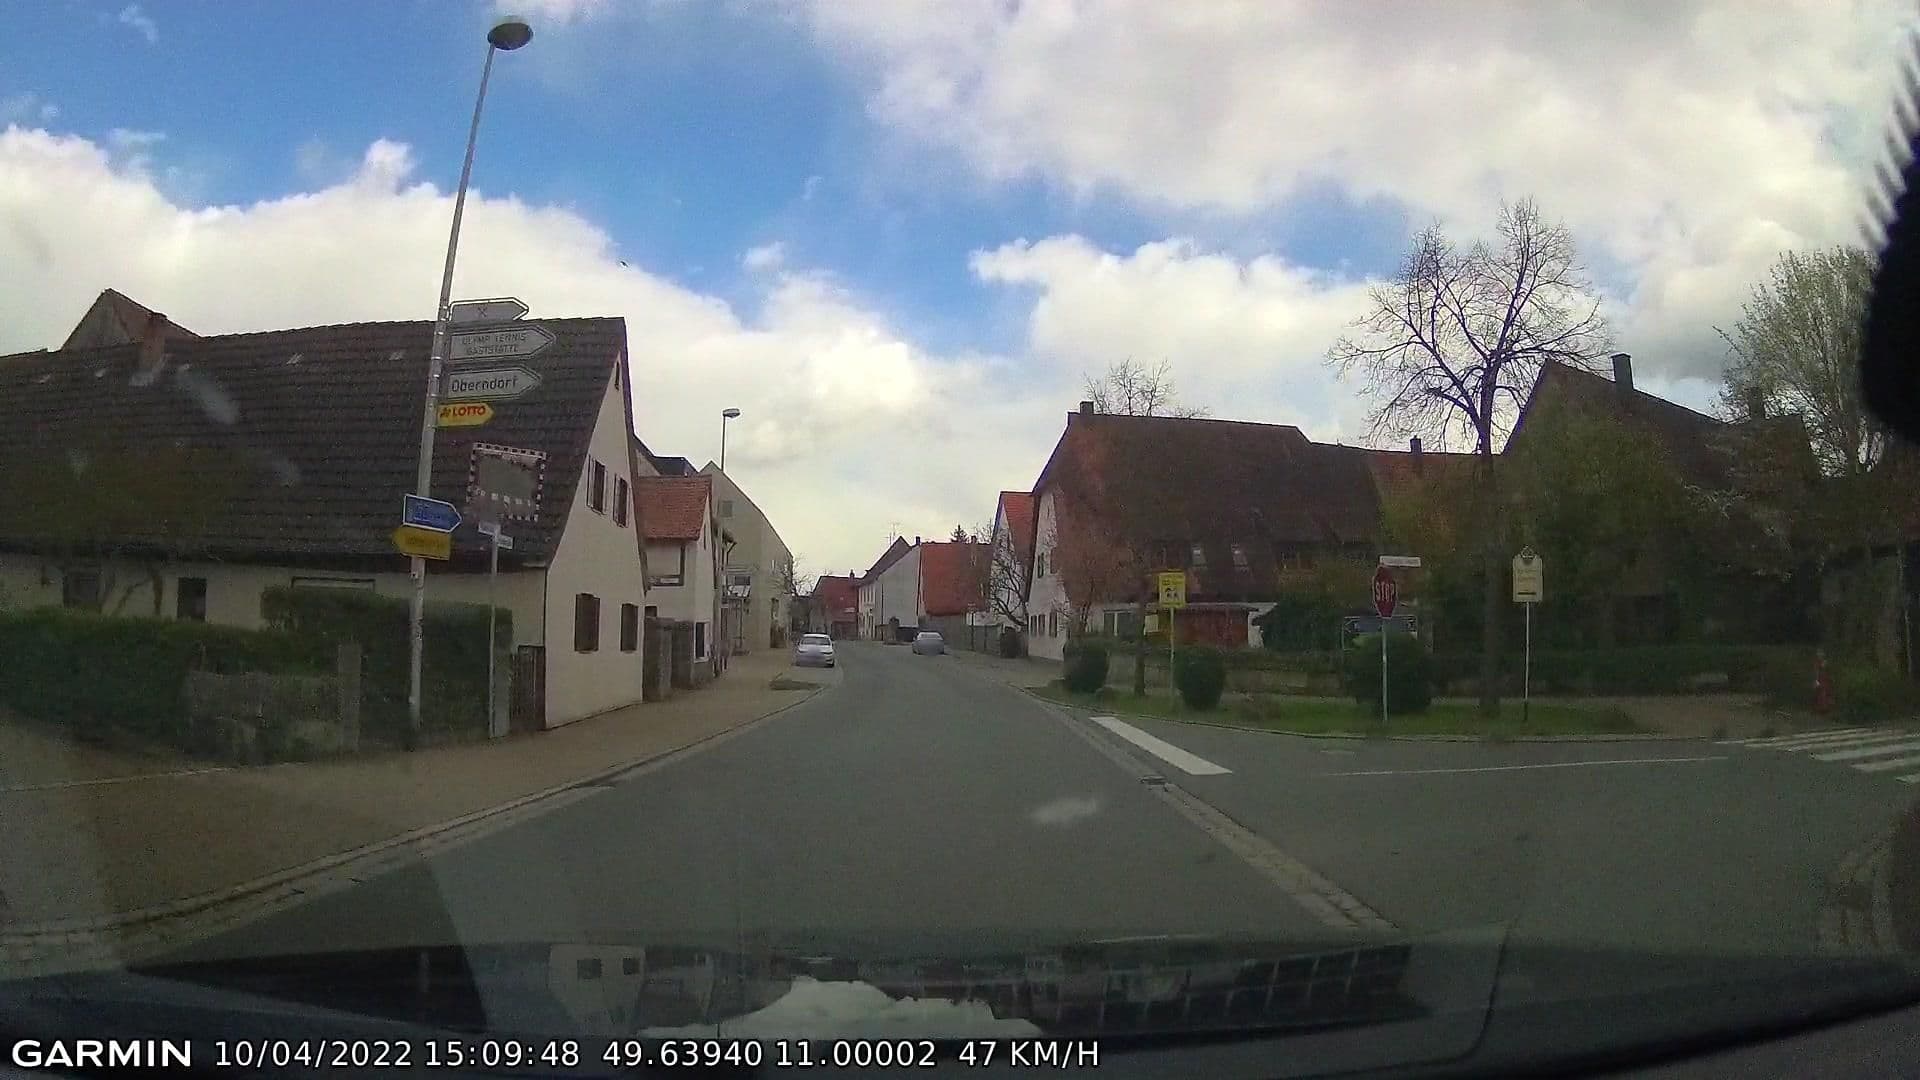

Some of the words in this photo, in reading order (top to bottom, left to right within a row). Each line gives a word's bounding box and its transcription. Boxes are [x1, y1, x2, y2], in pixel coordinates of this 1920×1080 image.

[451, 375, 518, 392] Oberndorf
[452, 405, 486, 417] LOTTO
[1375, 583, 1395, 602] STOP
